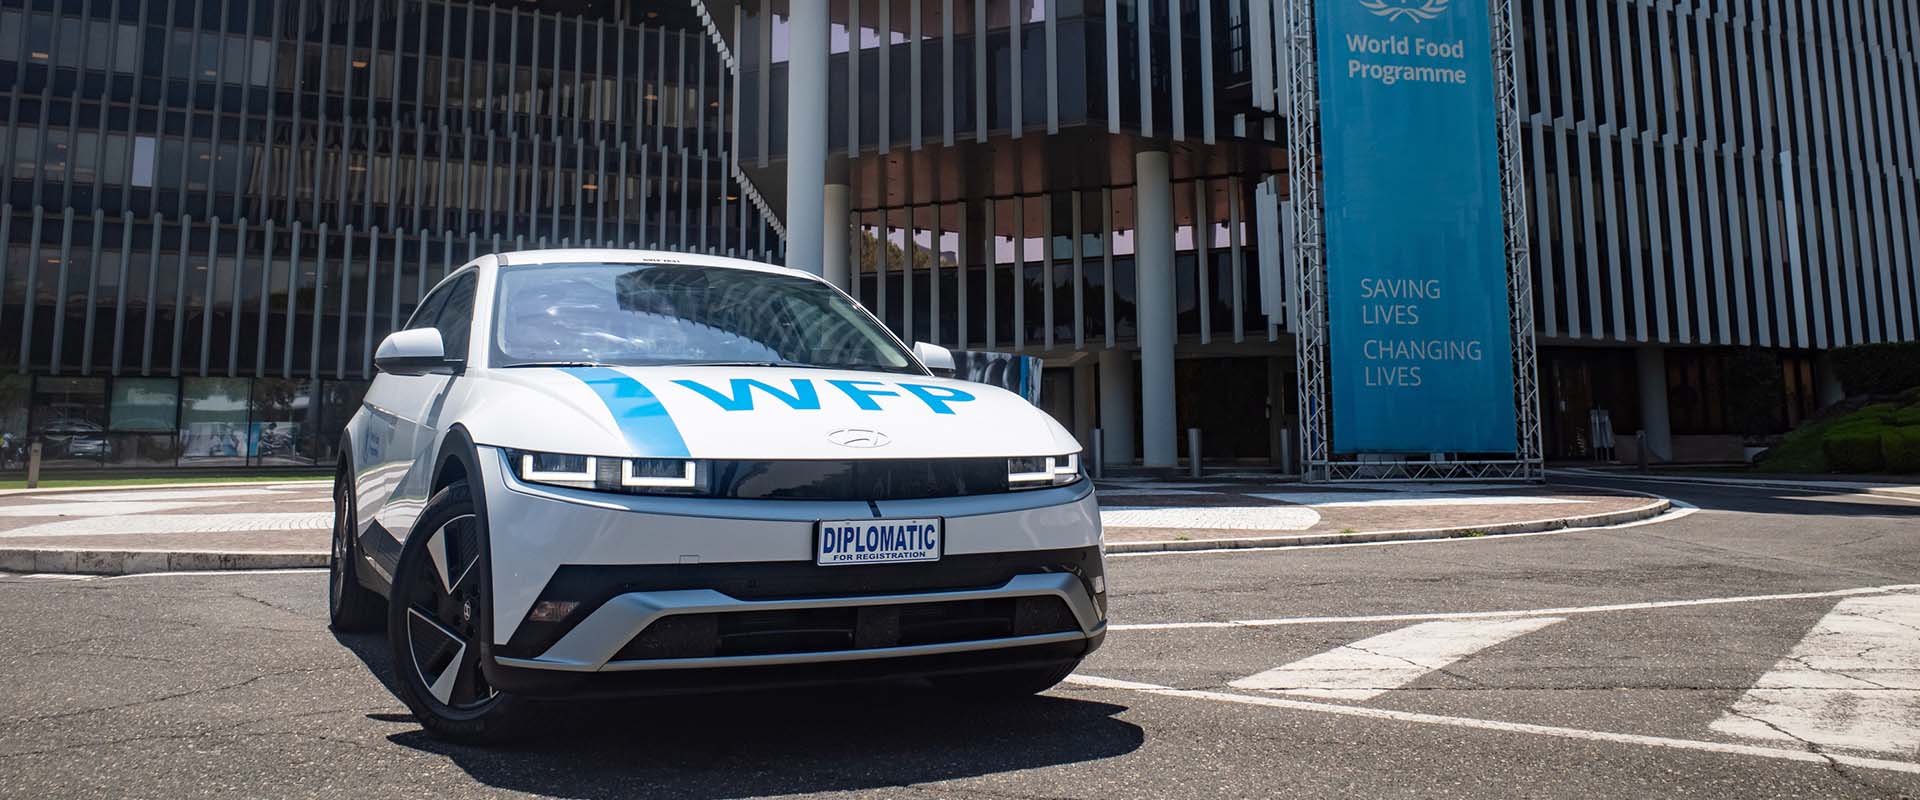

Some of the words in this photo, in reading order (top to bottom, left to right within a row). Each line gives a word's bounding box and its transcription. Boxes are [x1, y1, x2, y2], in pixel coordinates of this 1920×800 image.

[1346, 33, 1409, 55] World
[1415, 37, 1464, 59] Food
[1348, 59, 1466, 84] Programme
[1360, 278, 1441, 299] SAVING
[1362, 304, 1419, 324] LIVES
[1363, 339, 1482, 360] CHANGING
[1365, 366, 1422, 386] LIVES
[669, 378, 976, 415] WFP
[823, 524, 935, 554] DIPLOMATIC
[856, 551, 926, 560] REGISTRATION
